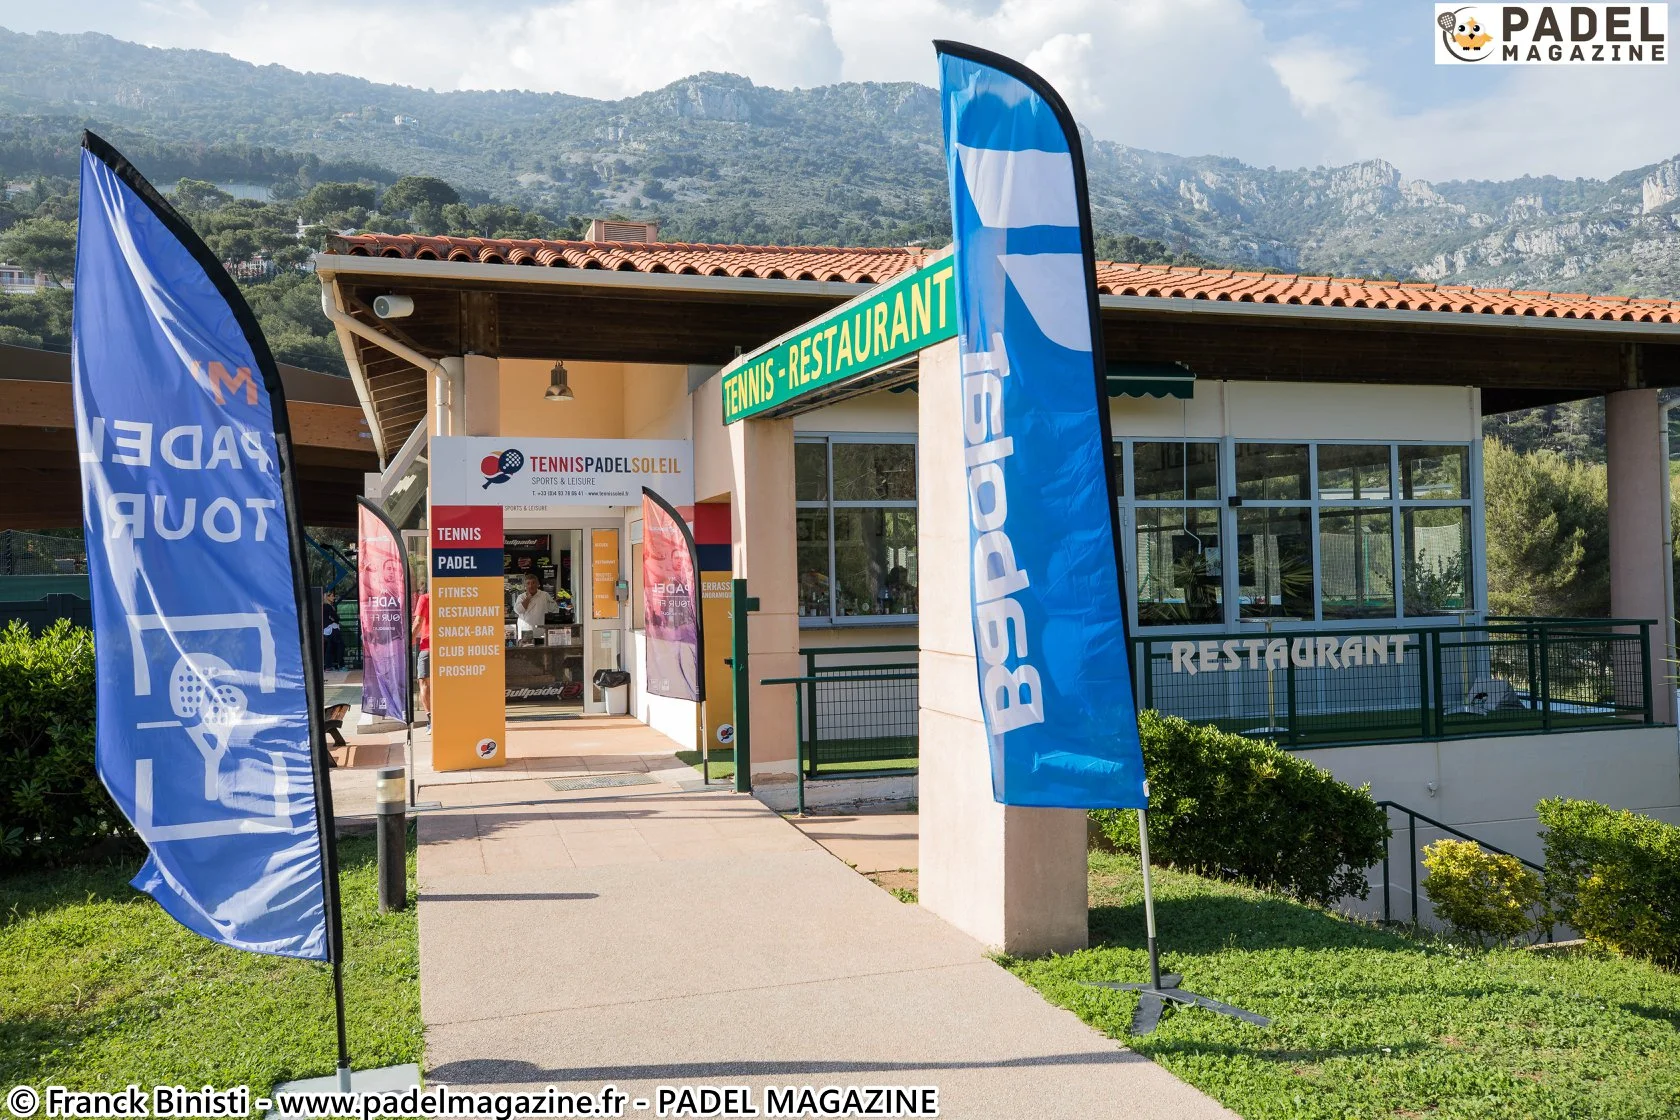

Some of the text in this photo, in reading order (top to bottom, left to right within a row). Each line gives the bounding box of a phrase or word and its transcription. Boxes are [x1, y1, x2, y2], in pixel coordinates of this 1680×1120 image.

[724, 357, 775, 417] TENNIS
[788, 265, 953, 390] RESTAURANT
[531, 476, 596, 486] SPORTS & LEISURE
[437, 527, 482, 541] TENNIS
[438, 555, 478, 570] PADEL
[438, 586, 479, 599] FITNESS
[438, 605, 500, 618] RESTAURANT
[438, 625, 495, 637] SNACK-BAR
[438, 644, 500, 657] CLUB HOUSE
[1171, 634, 1410, 676] RESTAURANT
[439, 664, 486, 677] PROSHOP
